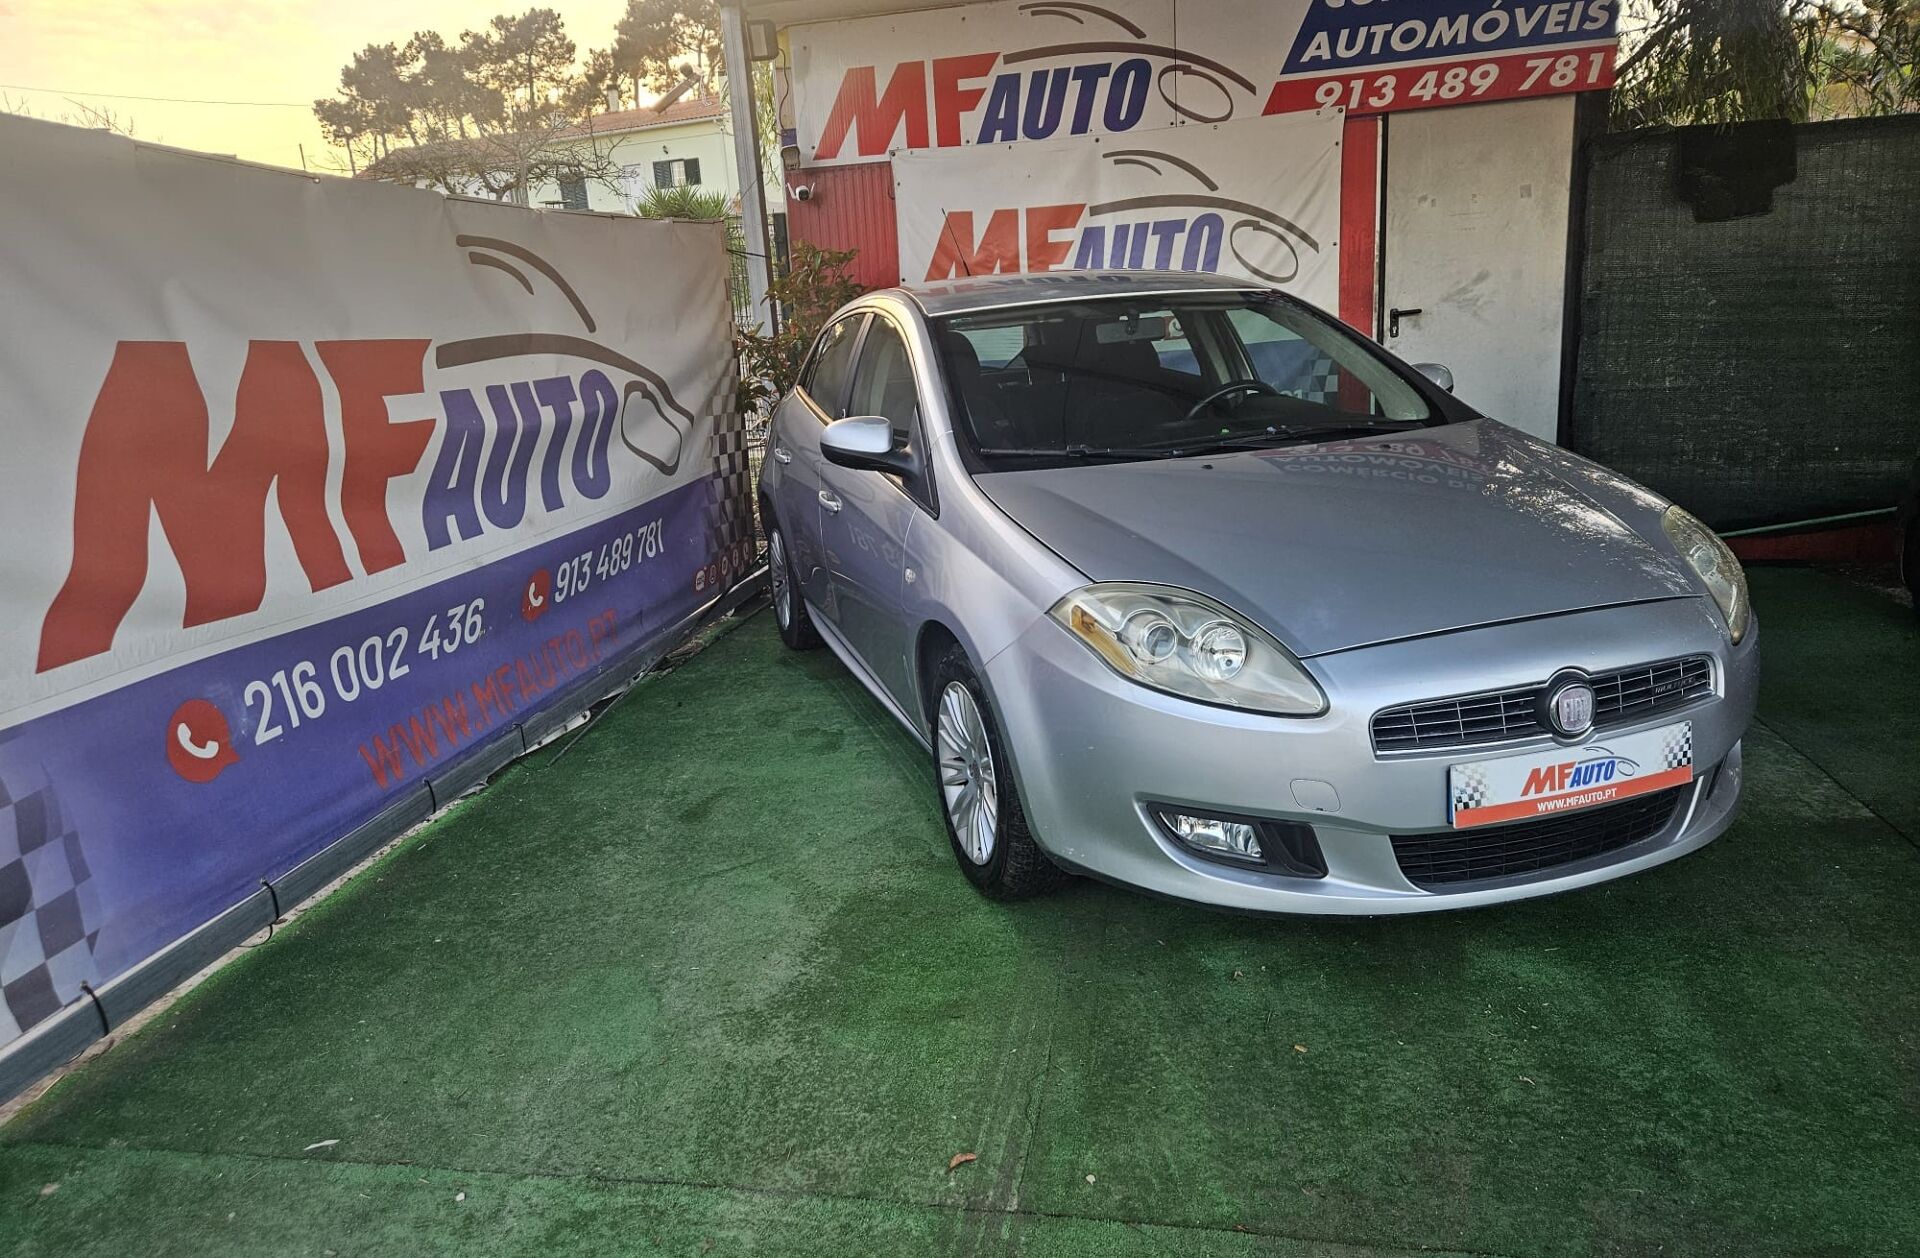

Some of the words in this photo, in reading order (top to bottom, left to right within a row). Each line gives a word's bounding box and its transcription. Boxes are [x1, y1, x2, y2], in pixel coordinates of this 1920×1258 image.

[1300, 0, 1610, 63] AUTOMÓVEIS
[1315, 75, 1397, 110] 913
[1408, 63, 1500, 102] 489
[1517, 52, 1606, 92] 781
[244, 660, 326, 746] 216
[330, 626, 410, 702] 002
[418, 598, 485, 660] 436
[554, 551, 593, 602] 913
[596, 533, 633, 582] 489
[637, 518, 665, 564] 781
[358, 608, 623, 790] WWW.MFAUTO.PT
[1537, 788, 1618, 812] WWW.MFAUTO.PT
